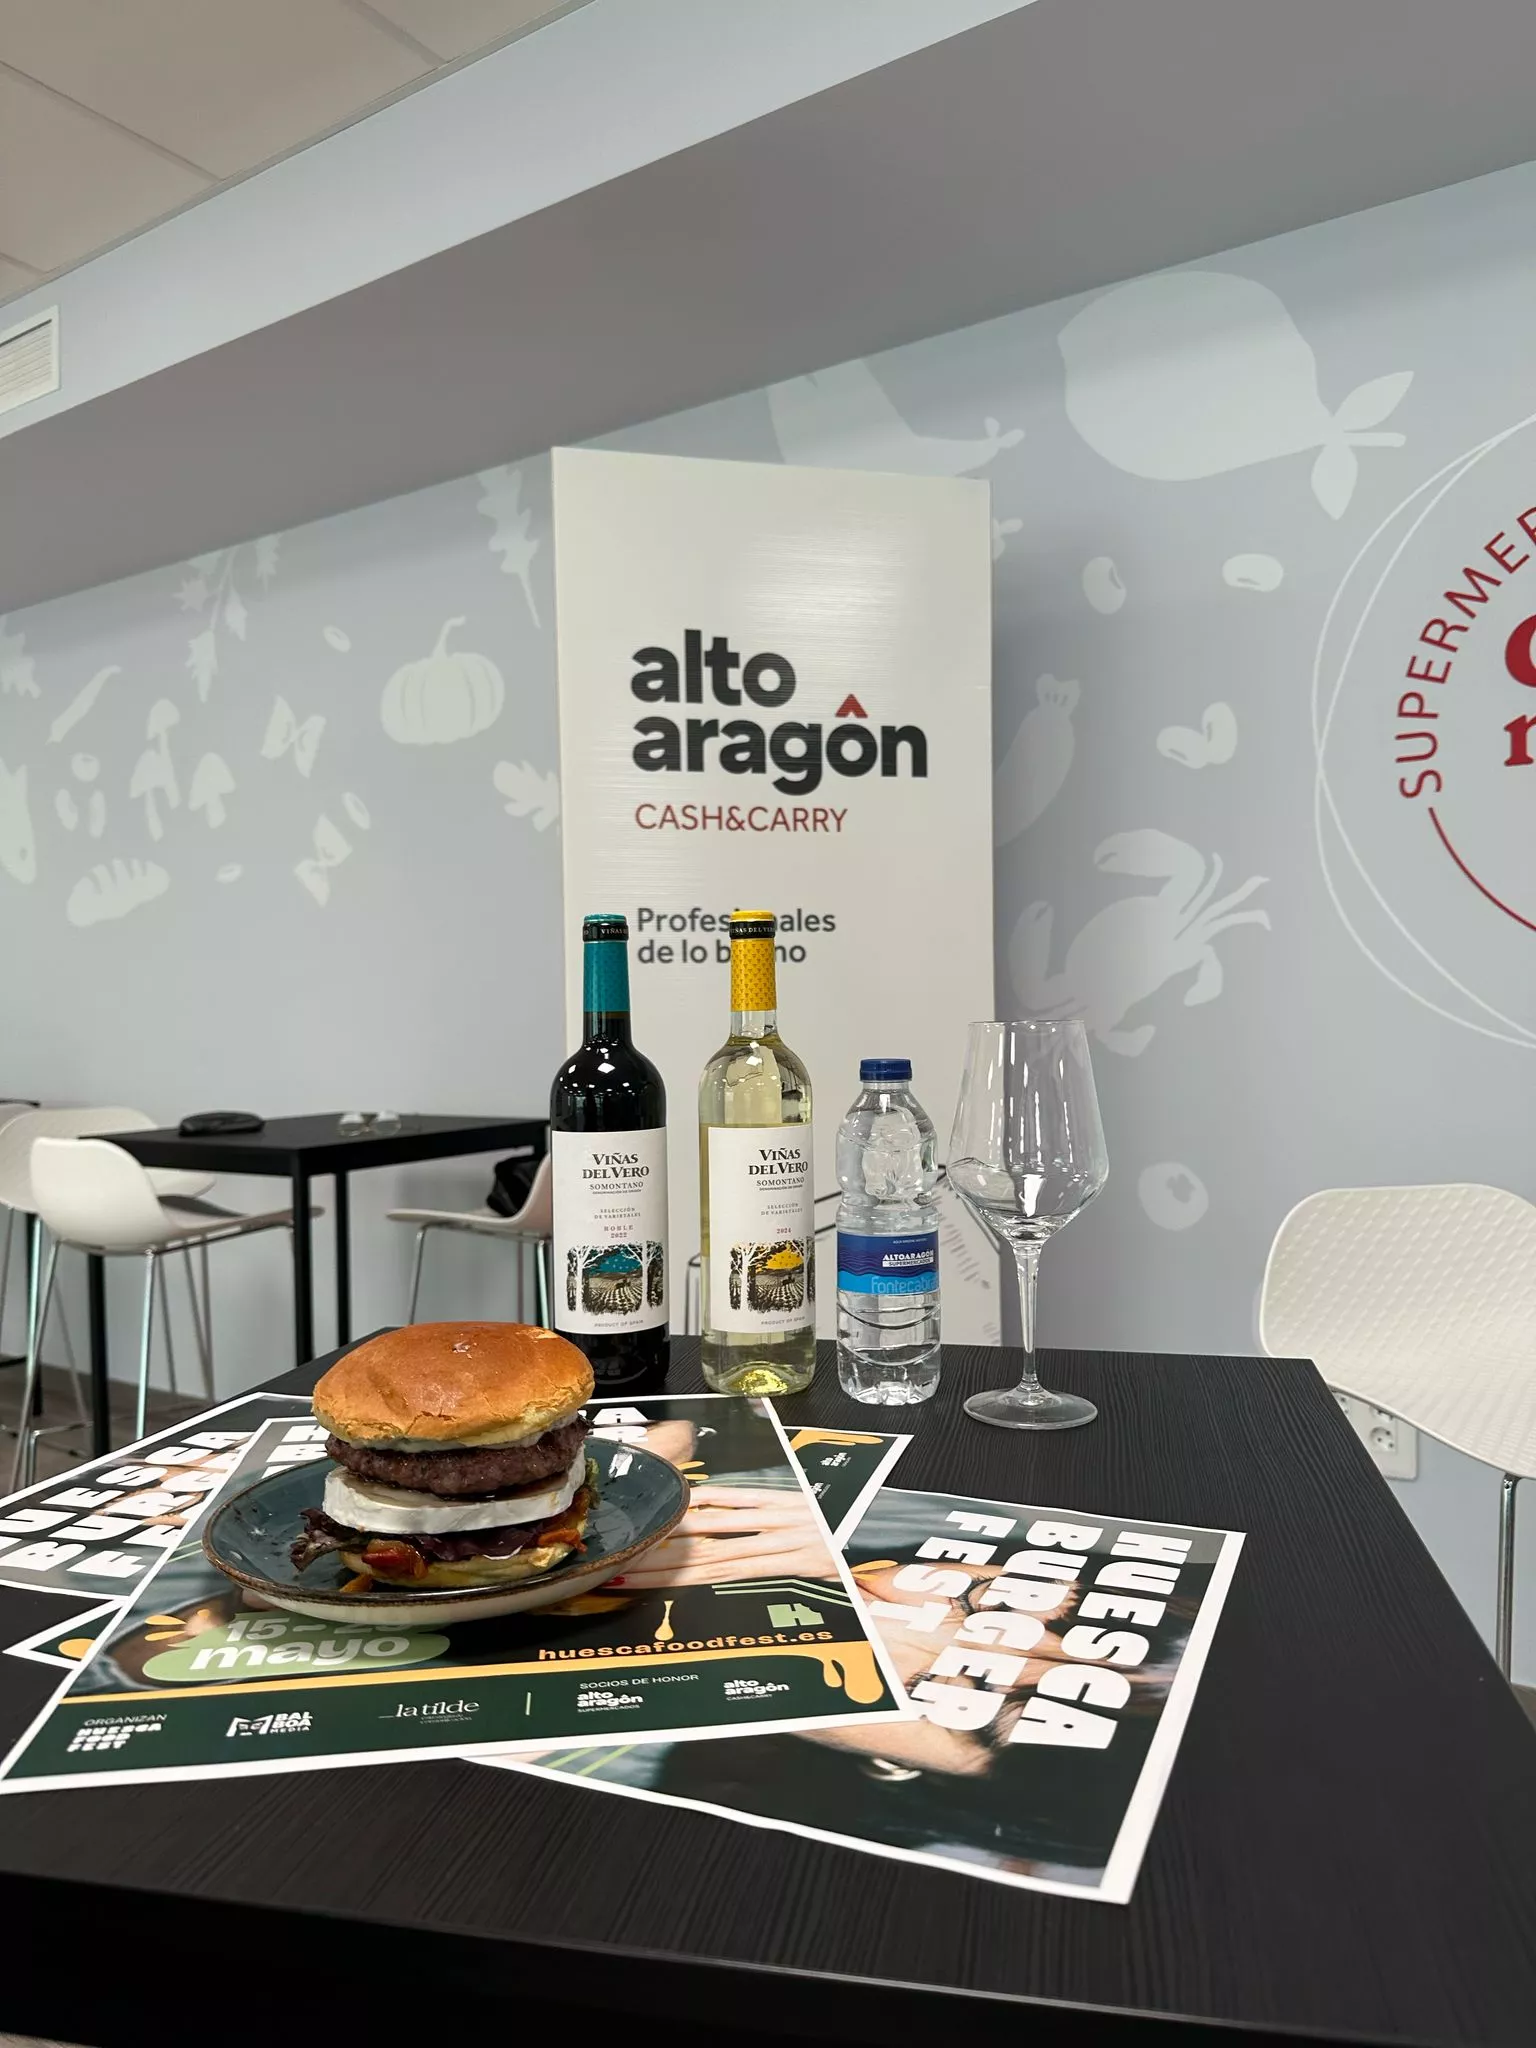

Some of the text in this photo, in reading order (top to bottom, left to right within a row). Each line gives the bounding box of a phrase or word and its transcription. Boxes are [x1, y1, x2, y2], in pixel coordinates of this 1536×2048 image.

[630, 629, 796, 708] alto
[635, 803, 848, 833] CASH&CARRY
[638, 907, 836, 933] Profesales
[638, 939, 806, 964] de lo bno
[592, 1152, 639, 1165] VIÑAS
[758, 1147, 801, 1161] VIÑAS
[582, 1166, 650, 1179] DEL VERO
[748, 1161, 808, 1175] DEL VERO
[589, 1181, 644, 1191] SOMONTANO
[756, 1177, 805, 1187] SOMONTANO
[0, 1431, 255, 1551] UESCA
[868, 1510, 1018, 1633] FEST
[912, 1520, 1104, 1731] BURGER
[538, 1629, 834, 1660] huescafoodfest.es
[1008, 1531, 1192, 1749] HUESCA
[188, 1636, 410, 1670] mayo
[579, 1680, 629, 1690] SOCIOS
[652, 1674, 699, 1683] HONOR
[723, 1679, 759, 1689] alto
[577, 1691, 614, 1701] alto
[421, 1699, 480, 1716] tilde
[577, 1704, 641, 1713] SUPERMERCADOS
[83, 1714, 168, 1727] ORGANIZAN
[275, 1711, 314, 1722] BAL
[269, 1726, 310, 1734] MEDIA
[271, 1719, 312, 1729] BOA
